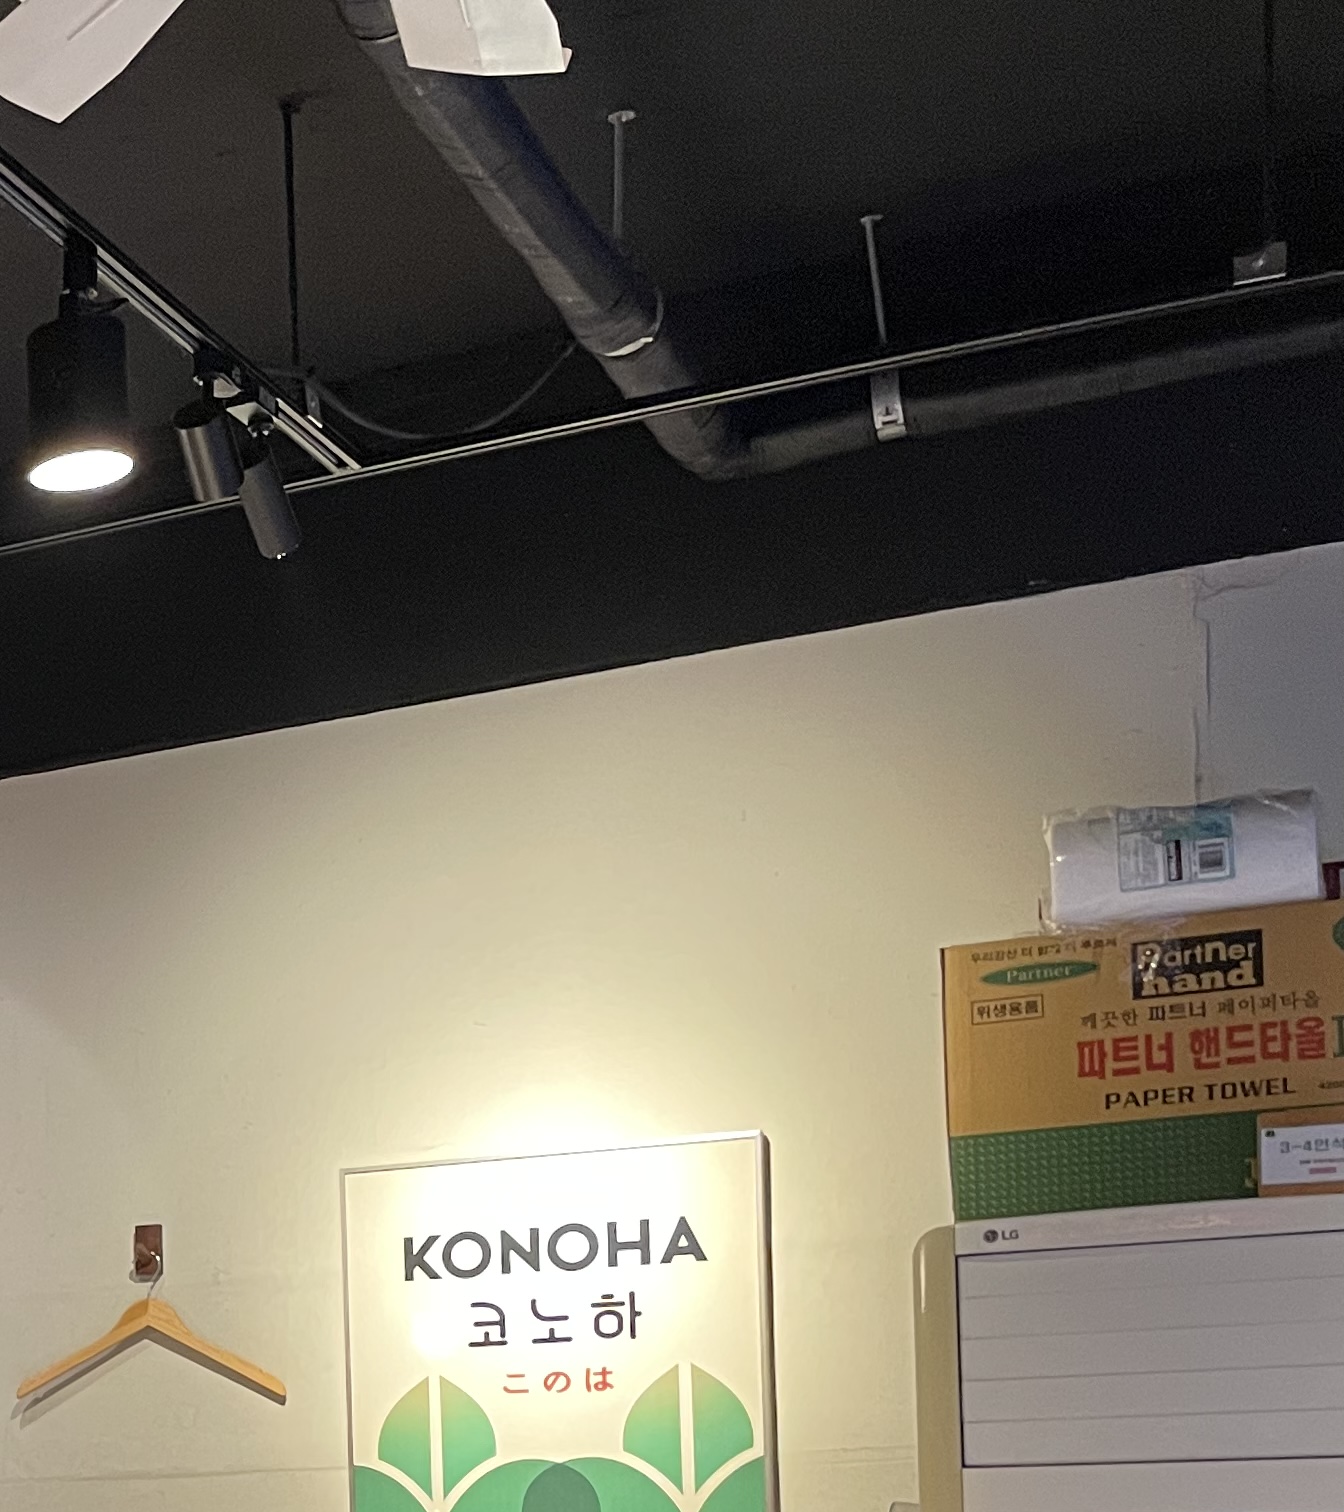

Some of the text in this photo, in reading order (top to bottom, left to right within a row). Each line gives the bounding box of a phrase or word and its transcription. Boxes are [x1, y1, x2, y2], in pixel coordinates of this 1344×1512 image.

[1006, 965, 1074, 984] Partner
[1141, 959, 1257, 997] hand
[1147, 1000, 1208, 1023] 파트너
[1076, 1031, 1176, 1080] 파트너
[1188, 1015, 1327, 1071] 핸드타올
[1104, 1076, 1297, 1111] PAPER TOWEL
[403, 1215, 709, 1282] KONOHA
[1000, 1229, 1020, 1241] LG
[468, 1291, 643, 1348] 코노하
[502, 1366, 615, 1394] このは
